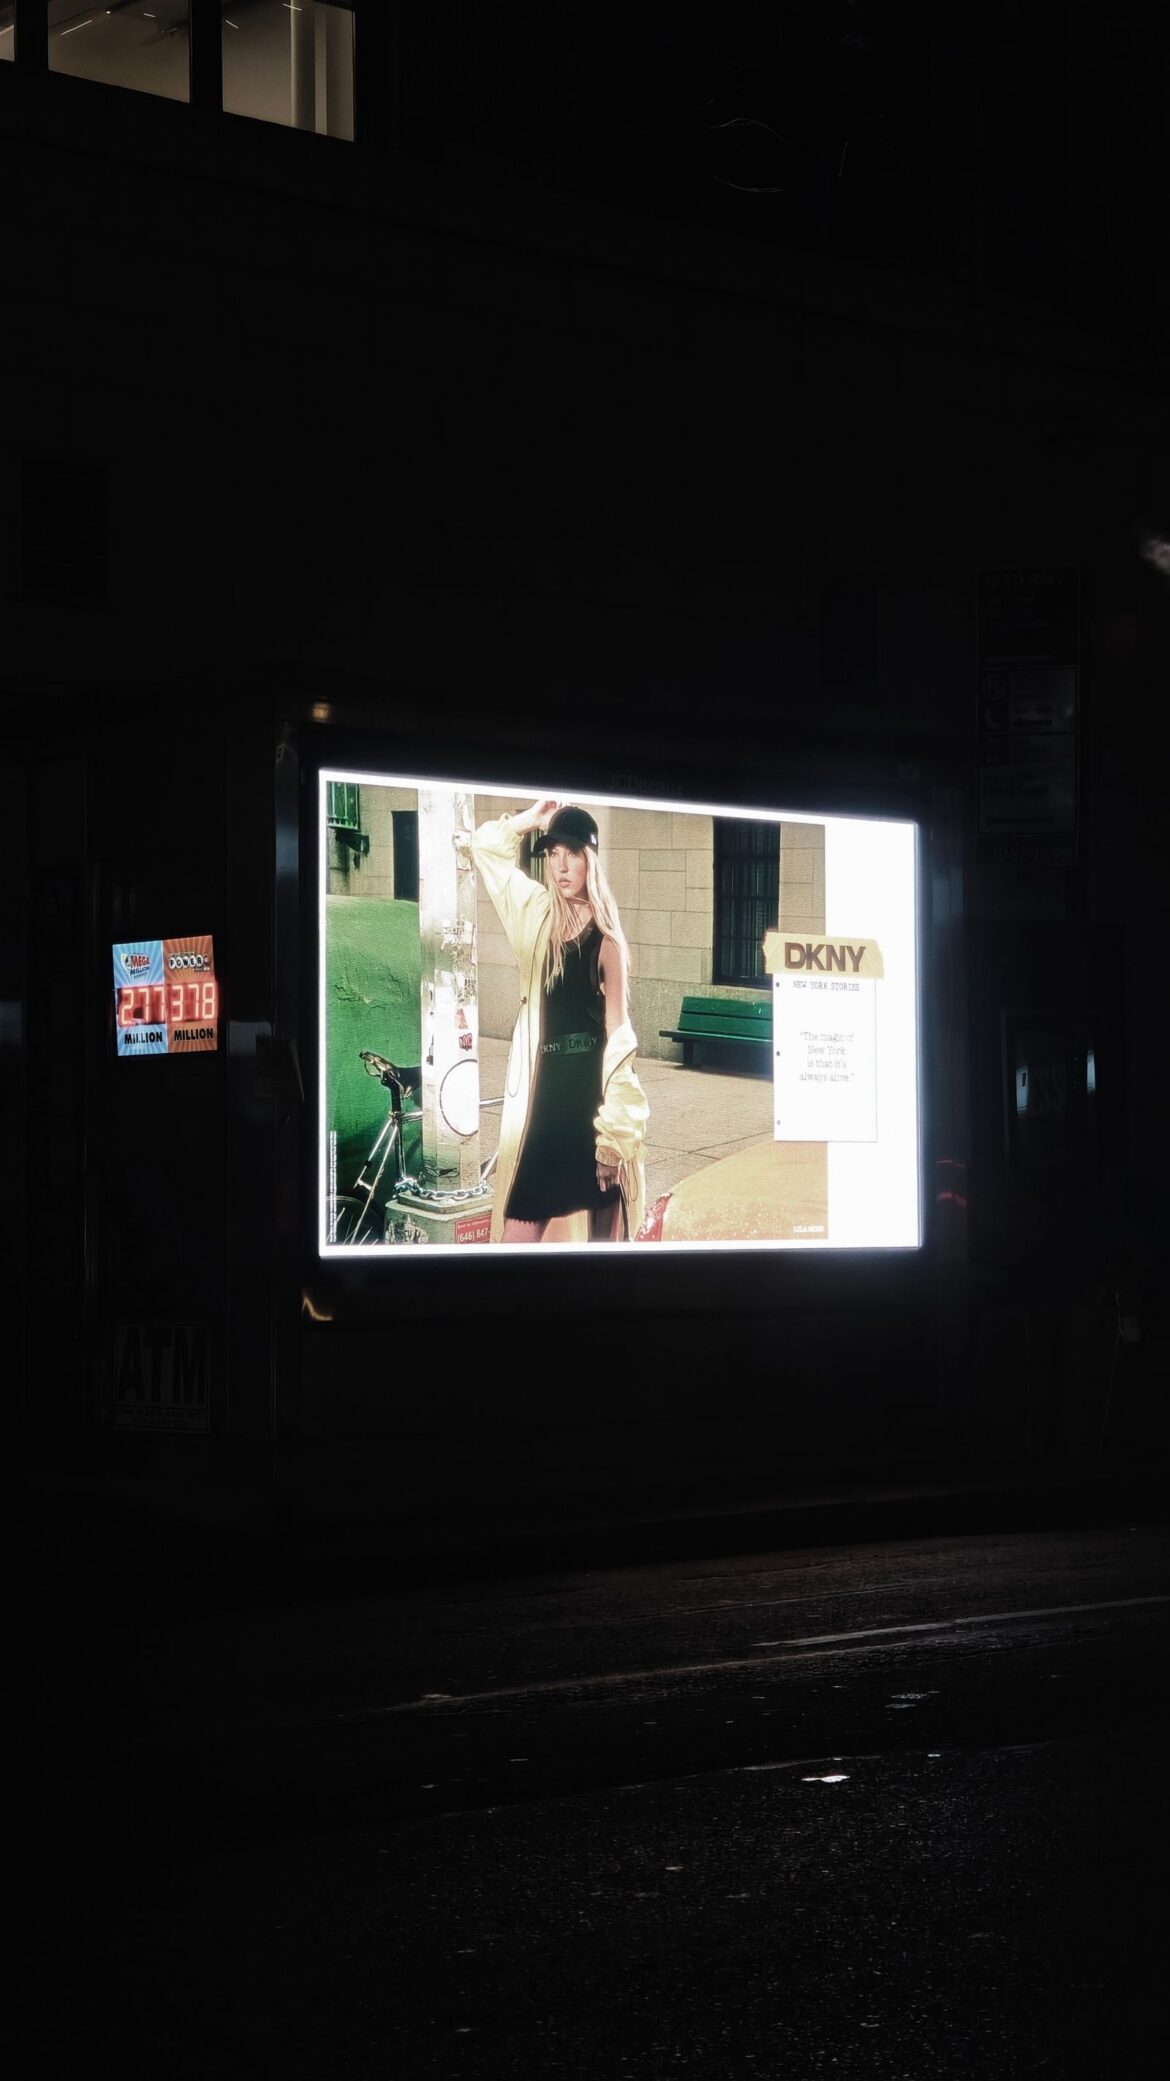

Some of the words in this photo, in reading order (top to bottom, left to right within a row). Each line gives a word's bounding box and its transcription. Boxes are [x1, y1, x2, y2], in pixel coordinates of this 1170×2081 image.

[784, 941, 866, 973] DKNY
[793, 980, 808, 989] NEW
[810, 981, 829, 990] YORK
[831, 982, 860, 991] STORIES
[122, 987, 165, 1024] 277
[171, 982, 216, 1022] 378
[124, 1031, 163, 1044] MILLION
[174, 1028, 213, 1041] MILLION
[820, 1033, 844, 1044] magic
[845, 1033, 855, 1042] of
[808, 1045, 825, 1055] New
[827, 1045, 846, 1056] York
[807, 1059, 814, 1068] is
[816, 1059, 833, 1068] that
[799, 1072, 828, 1084] always
[117, 1327, 206, 1405] ATM
